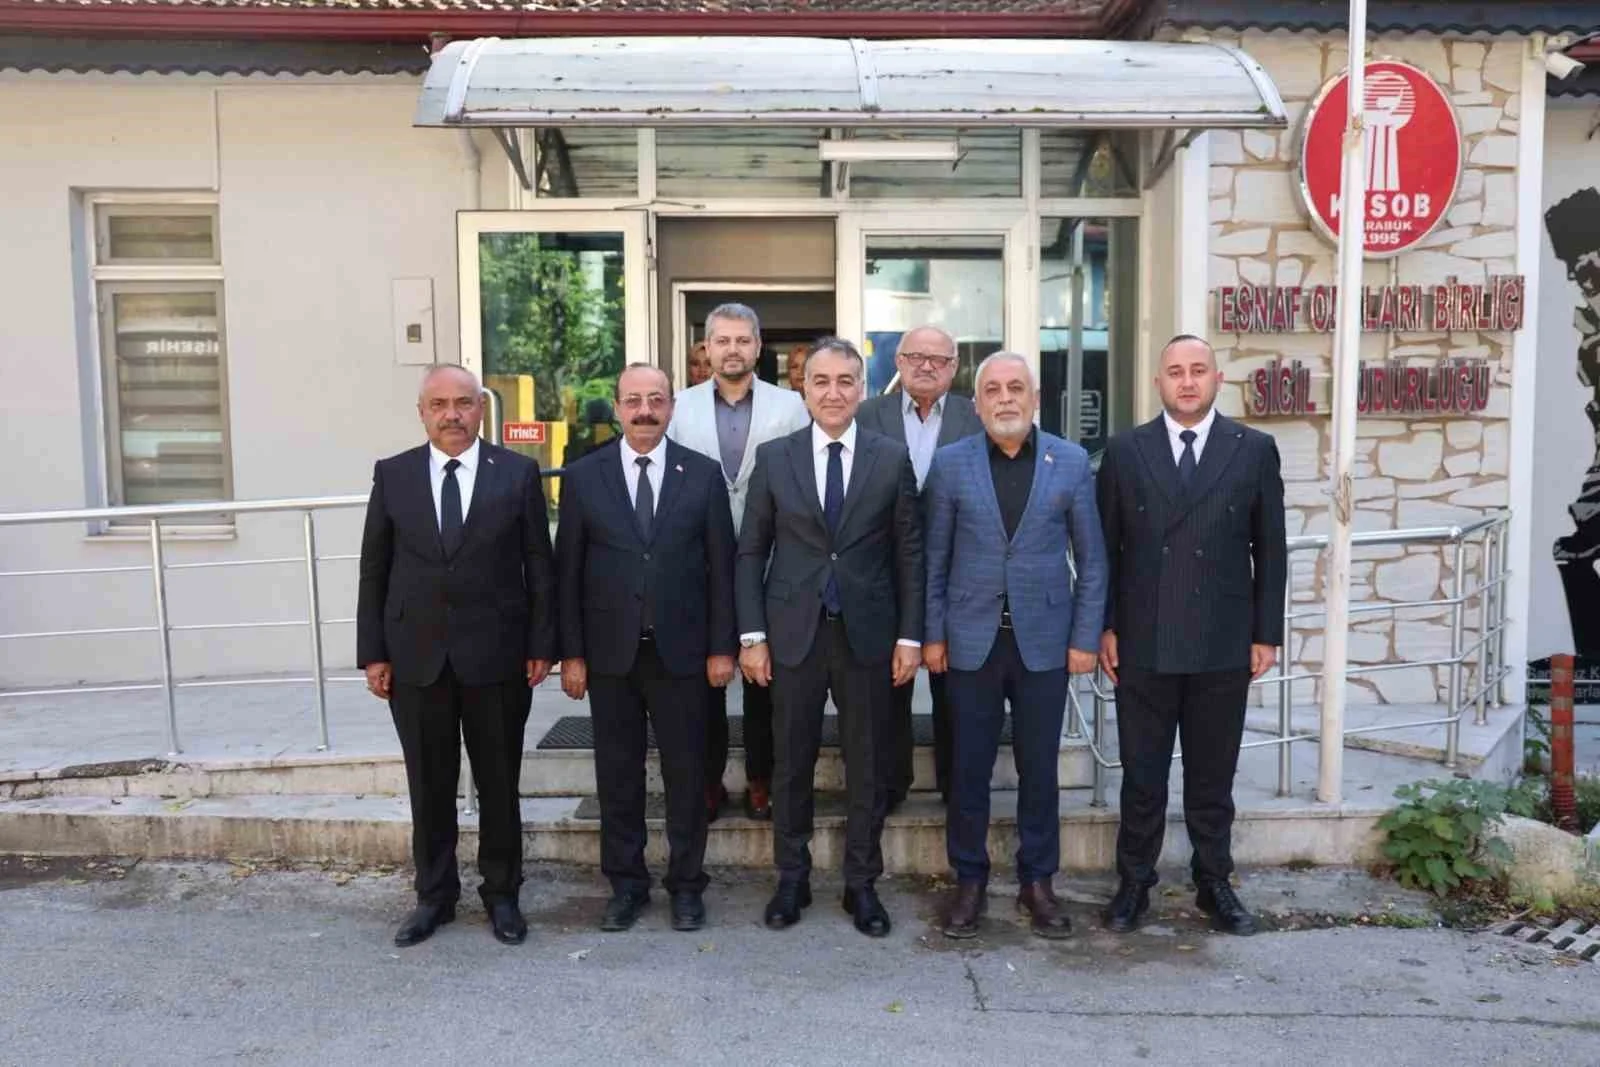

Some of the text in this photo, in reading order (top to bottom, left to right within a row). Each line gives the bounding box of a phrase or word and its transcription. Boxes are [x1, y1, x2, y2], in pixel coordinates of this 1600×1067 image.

[1330, 193, 1430, 217] KSOB
[1366, 220, 1412, 231] RABÜK
[1219, 275, 1524, 332] ESNAF OLARI BİRLİĞİ
[1252, 358, 1490, 415] SİCİL ÜDÜRLÜĞÜ
